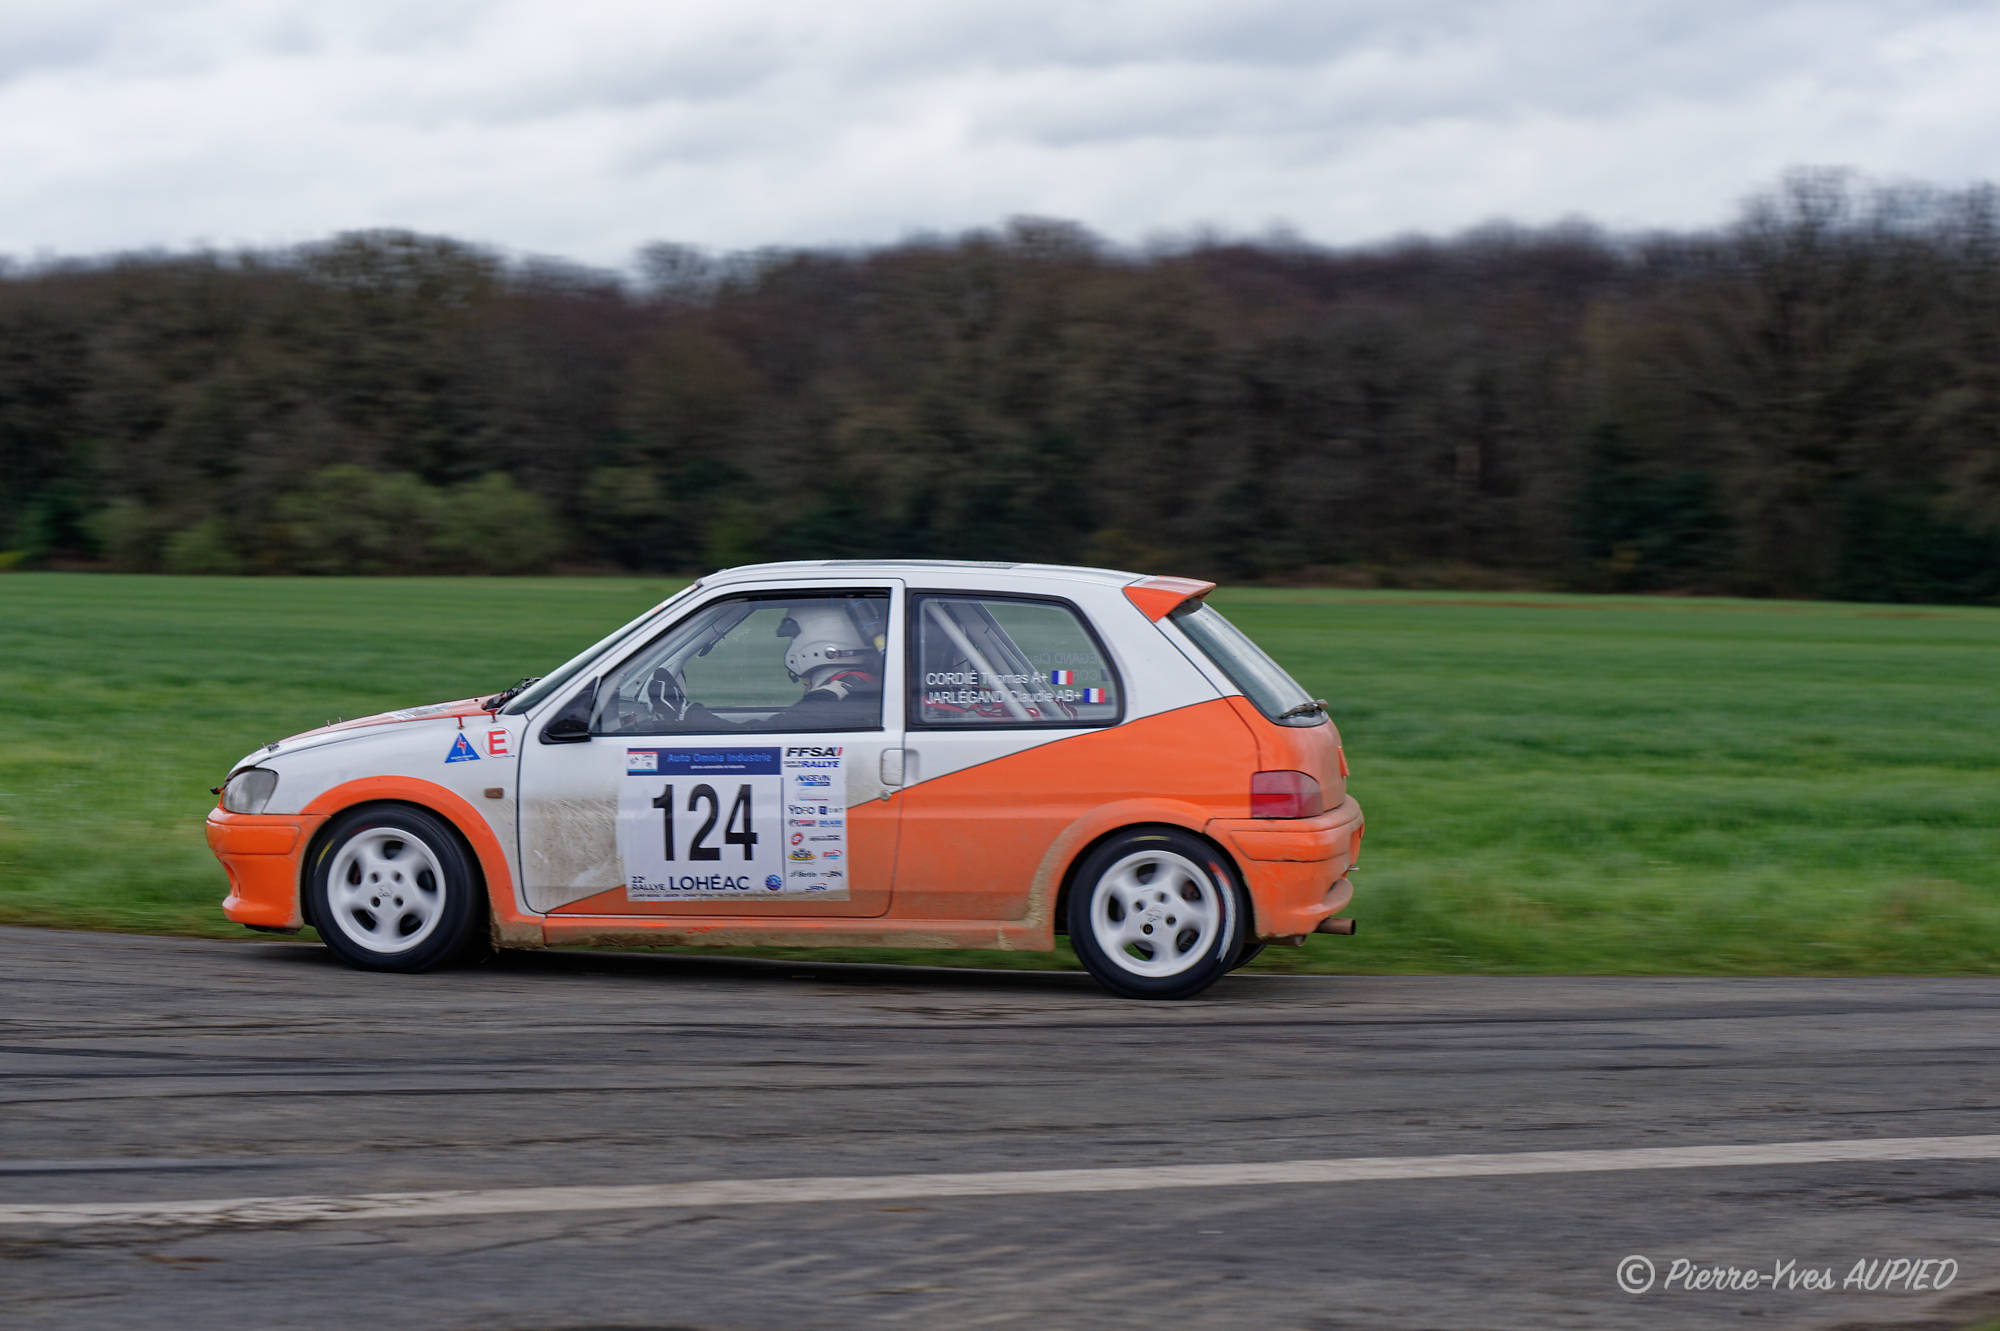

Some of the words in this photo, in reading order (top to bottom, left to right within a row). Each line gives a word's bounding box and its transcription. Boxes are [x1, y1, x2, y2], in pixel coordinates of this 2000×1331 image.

[925, 669, 978, 685] CORDIÉ
[1055, 689, 1083, 703] AB+
[488, 730, 508, 755] E
[667, 753, 691, 762] Auto
[692, 753, 725, 762] Omnia
[726, 752, 772, 762] Industrie
[785, 747, 836, 757] FFSA
[801, 760, 840, 768] RALLYE
[652, 783, 758, 861] 124
[631, 883, 666, 892] RALLYE
[669, 874, 750, 891] LOHÉAC
